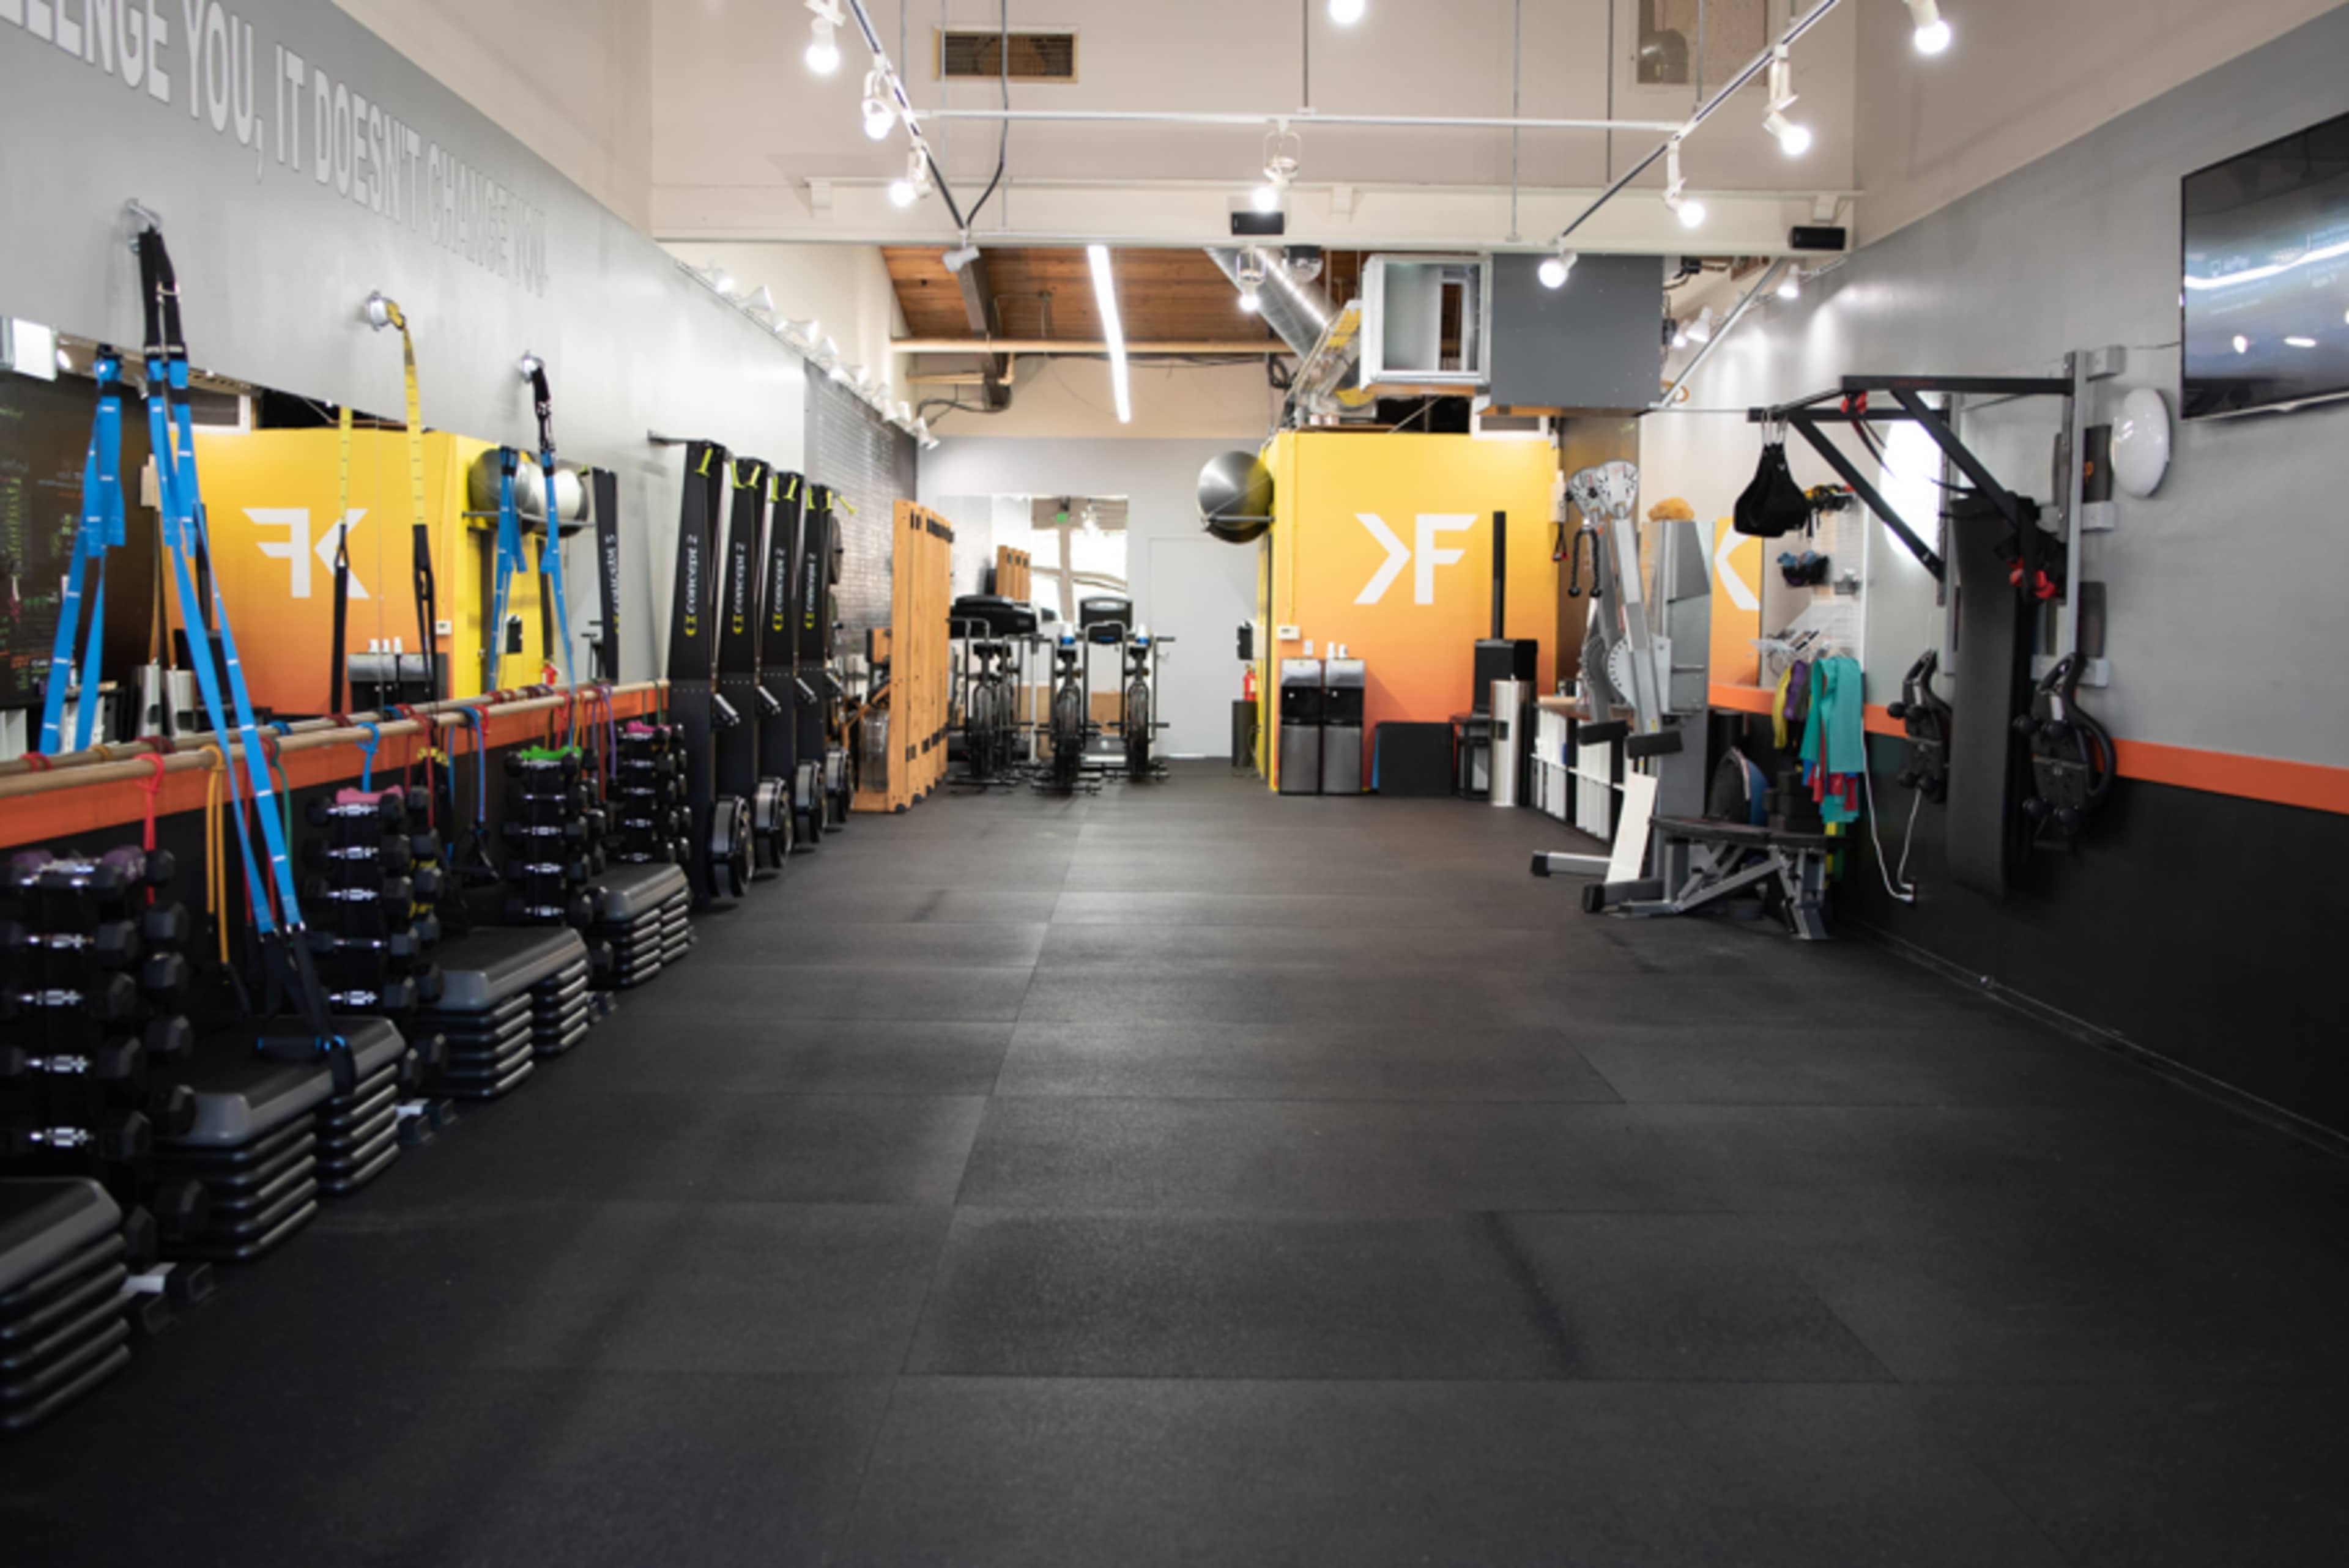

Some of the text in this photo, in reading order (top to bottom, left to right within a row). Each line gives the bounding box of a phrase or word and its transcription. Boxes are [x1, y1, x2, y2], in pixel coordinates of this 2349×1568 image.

[0, 0, 169, 103] NGE
[184, 0, 264, 184] YOU,
[276, 43, 304, 171] IT
[314, 68, 421, 233] DOESN'T
[429, 142, 508, 277] CHANGE
